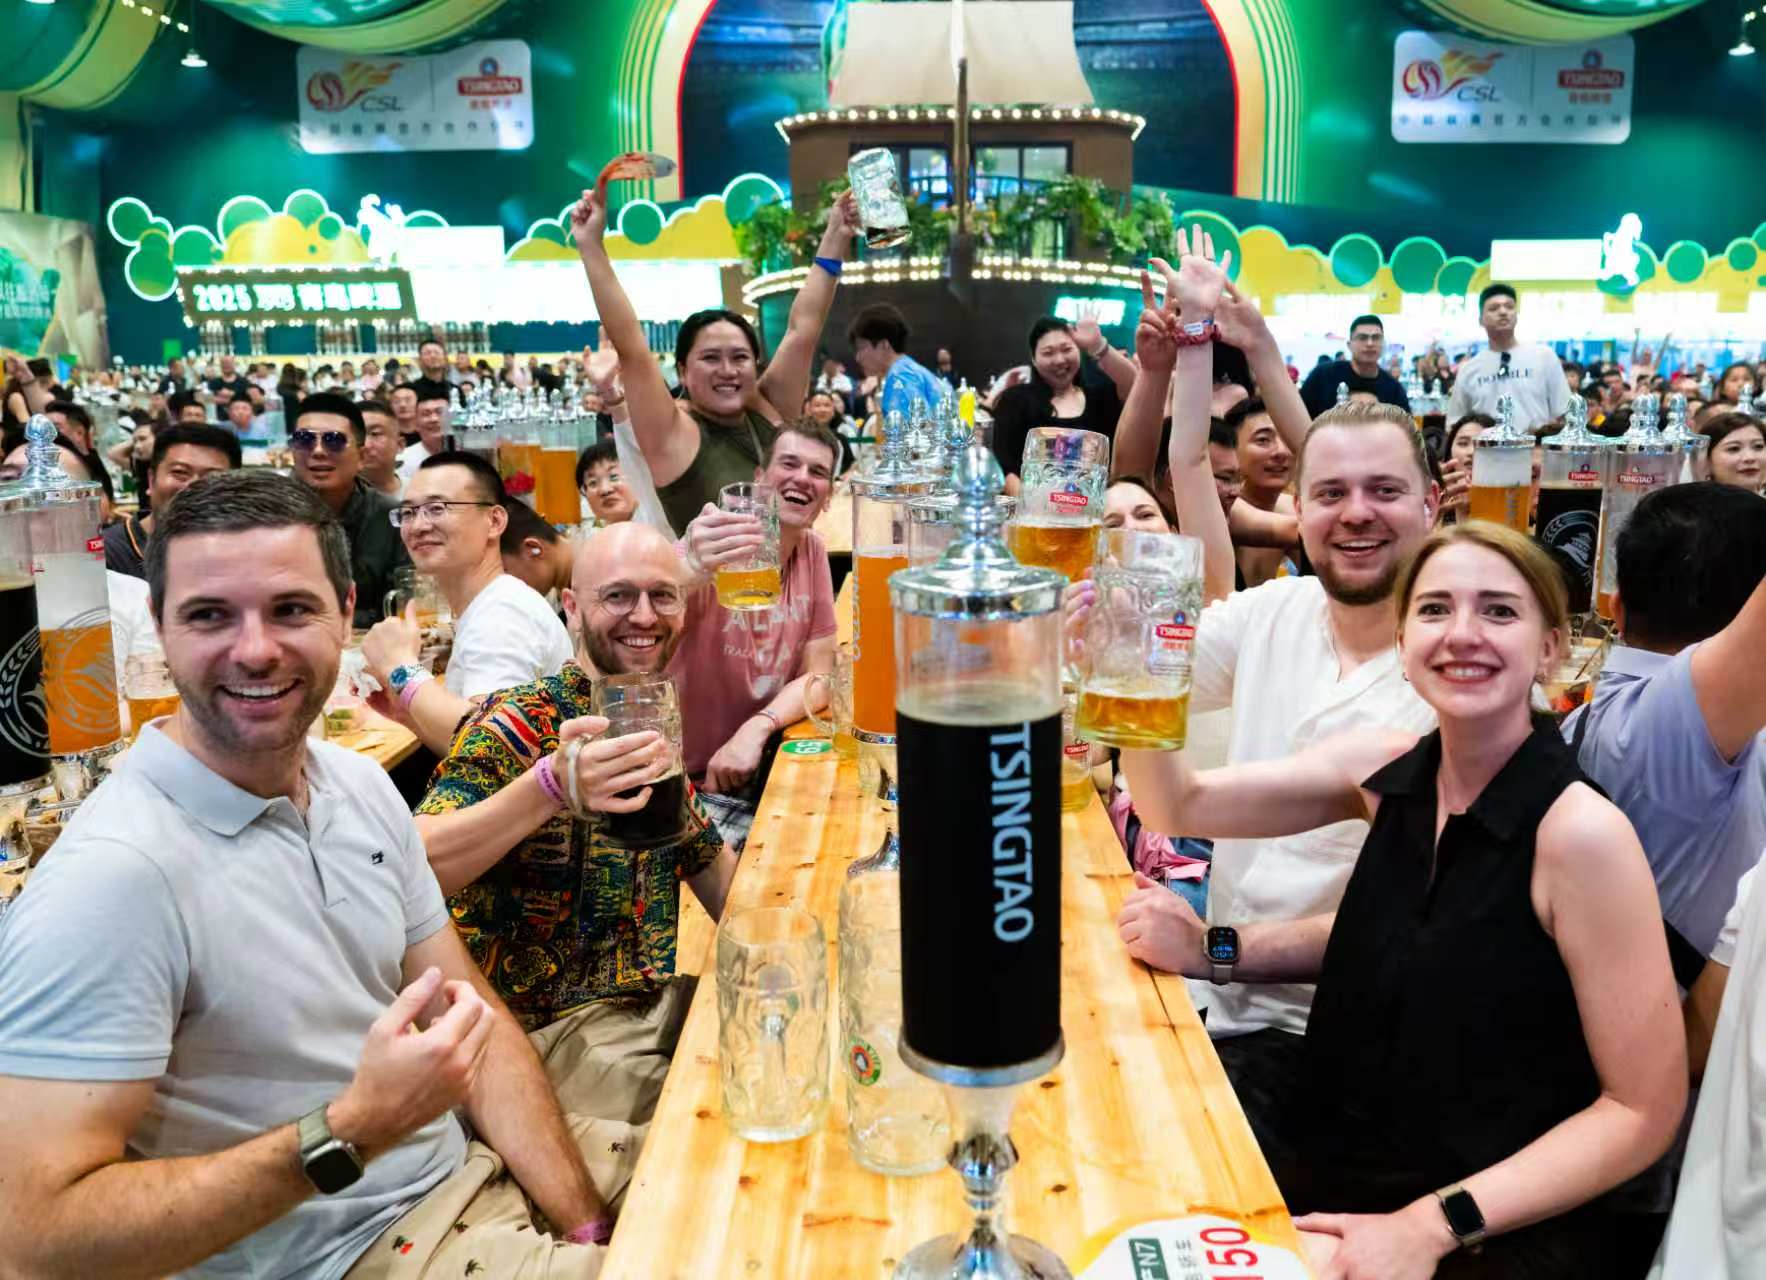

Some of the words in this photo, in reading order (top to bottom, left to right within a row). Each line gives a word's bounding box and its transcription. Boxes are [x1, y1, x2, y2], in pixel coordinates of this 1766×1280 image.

[360, 95, 404, 112] CSL
[1457, 85, 1500, 102] CSL
[193, 284, 252, 311] 2025
[990, 720, 1034, 943] TSINGTAO
